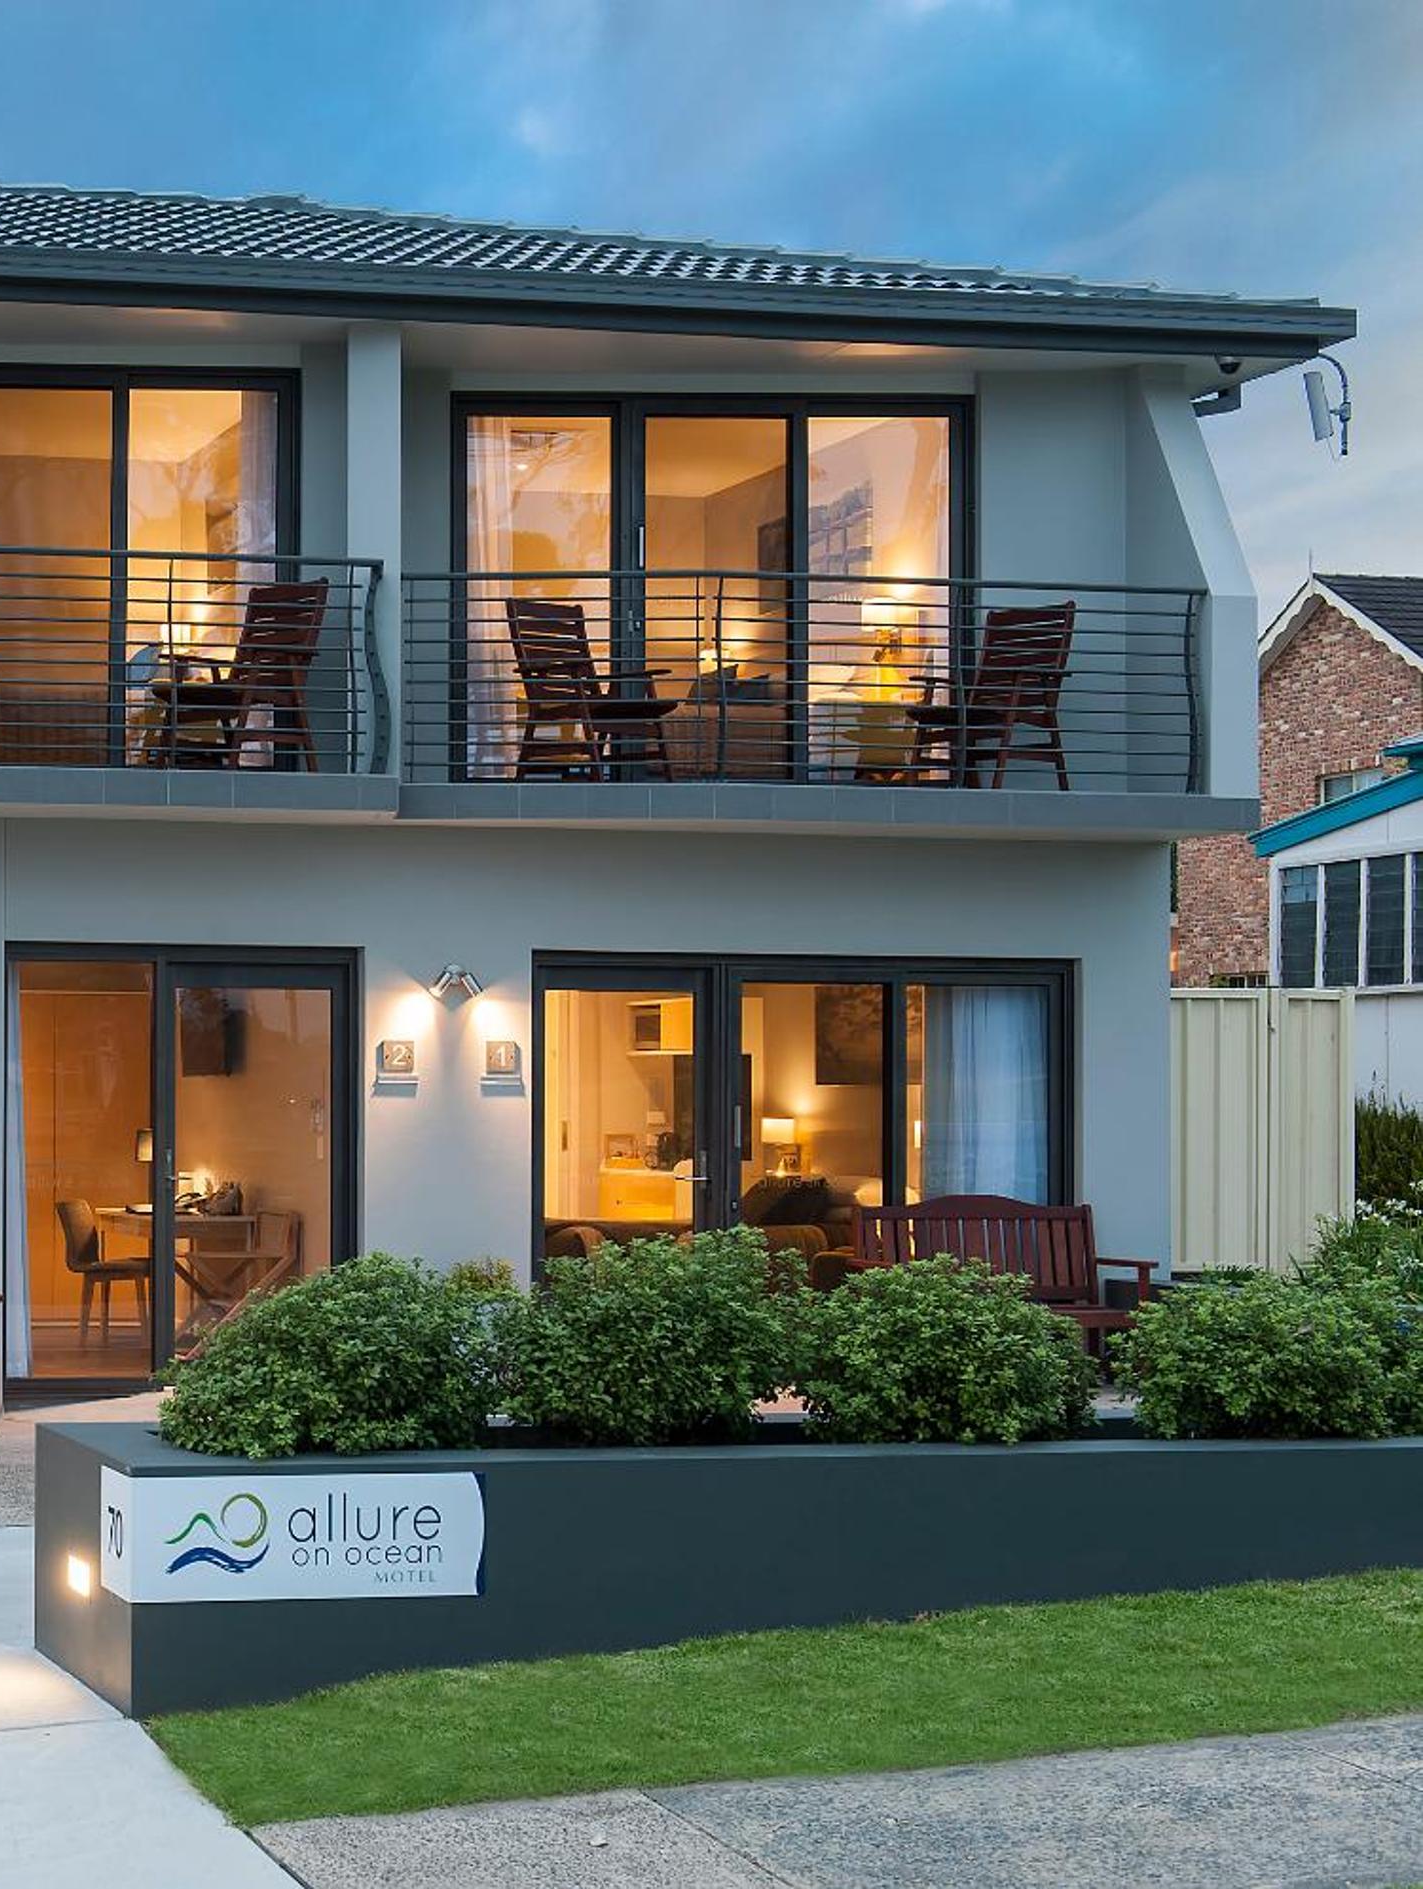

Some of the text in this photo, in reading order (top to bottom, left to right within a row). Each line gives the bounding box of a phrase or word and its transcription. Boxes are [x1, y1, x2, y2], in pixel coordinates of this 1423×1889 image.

[392, 1044, 407, 1065] 2
[495, 1045, 507, 1066] 1
[287, 1492, 443, 1543] allure
[107, 1504, 123, 1560] 70
[292, 1544, 442, 1566] on ocean
[375, 1569, 437, 1583] MOTEL
